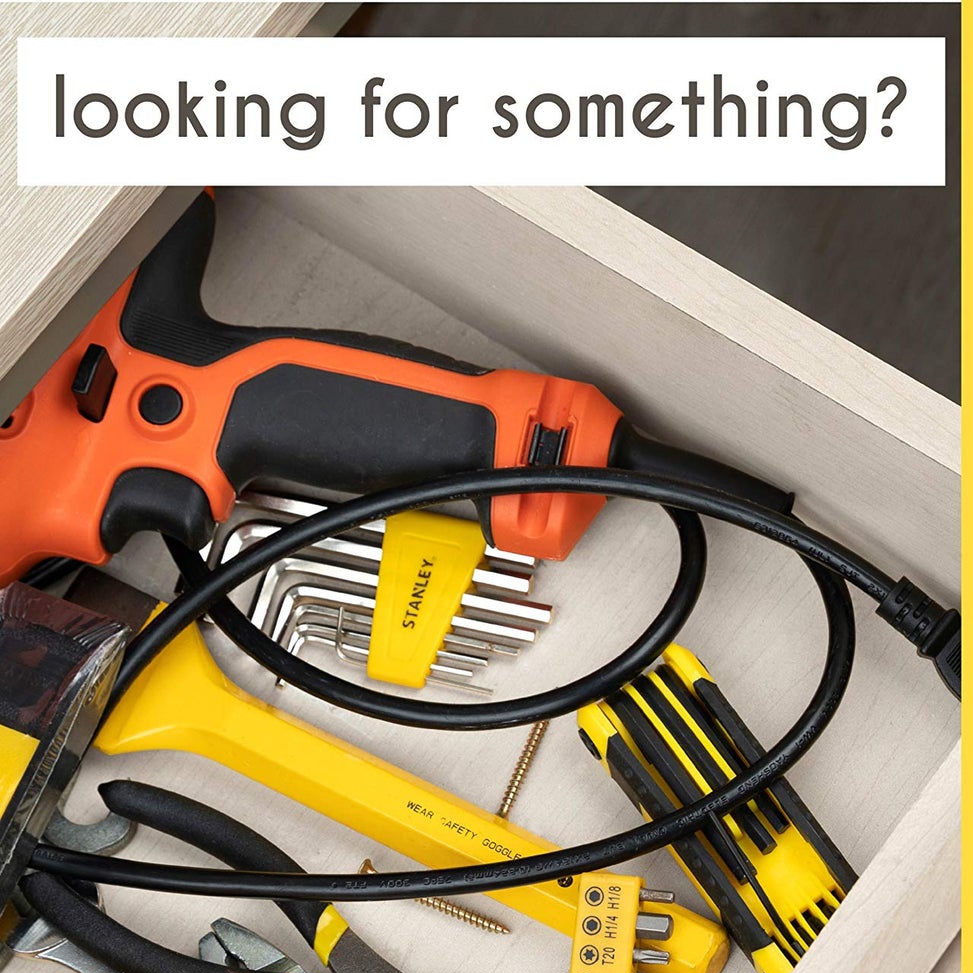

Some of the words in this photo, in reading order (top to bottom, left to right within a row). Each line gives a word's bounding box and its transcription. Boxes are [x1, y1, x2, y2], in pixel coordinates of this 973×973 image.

[402, 558, 434, 629] STANLEY
[407, 800, 434, 819] WEAR
[607, 885, 622, 910] H1/8
[605, 915, 619, 940] H1/4
[602, 946, 615, 966] T20
